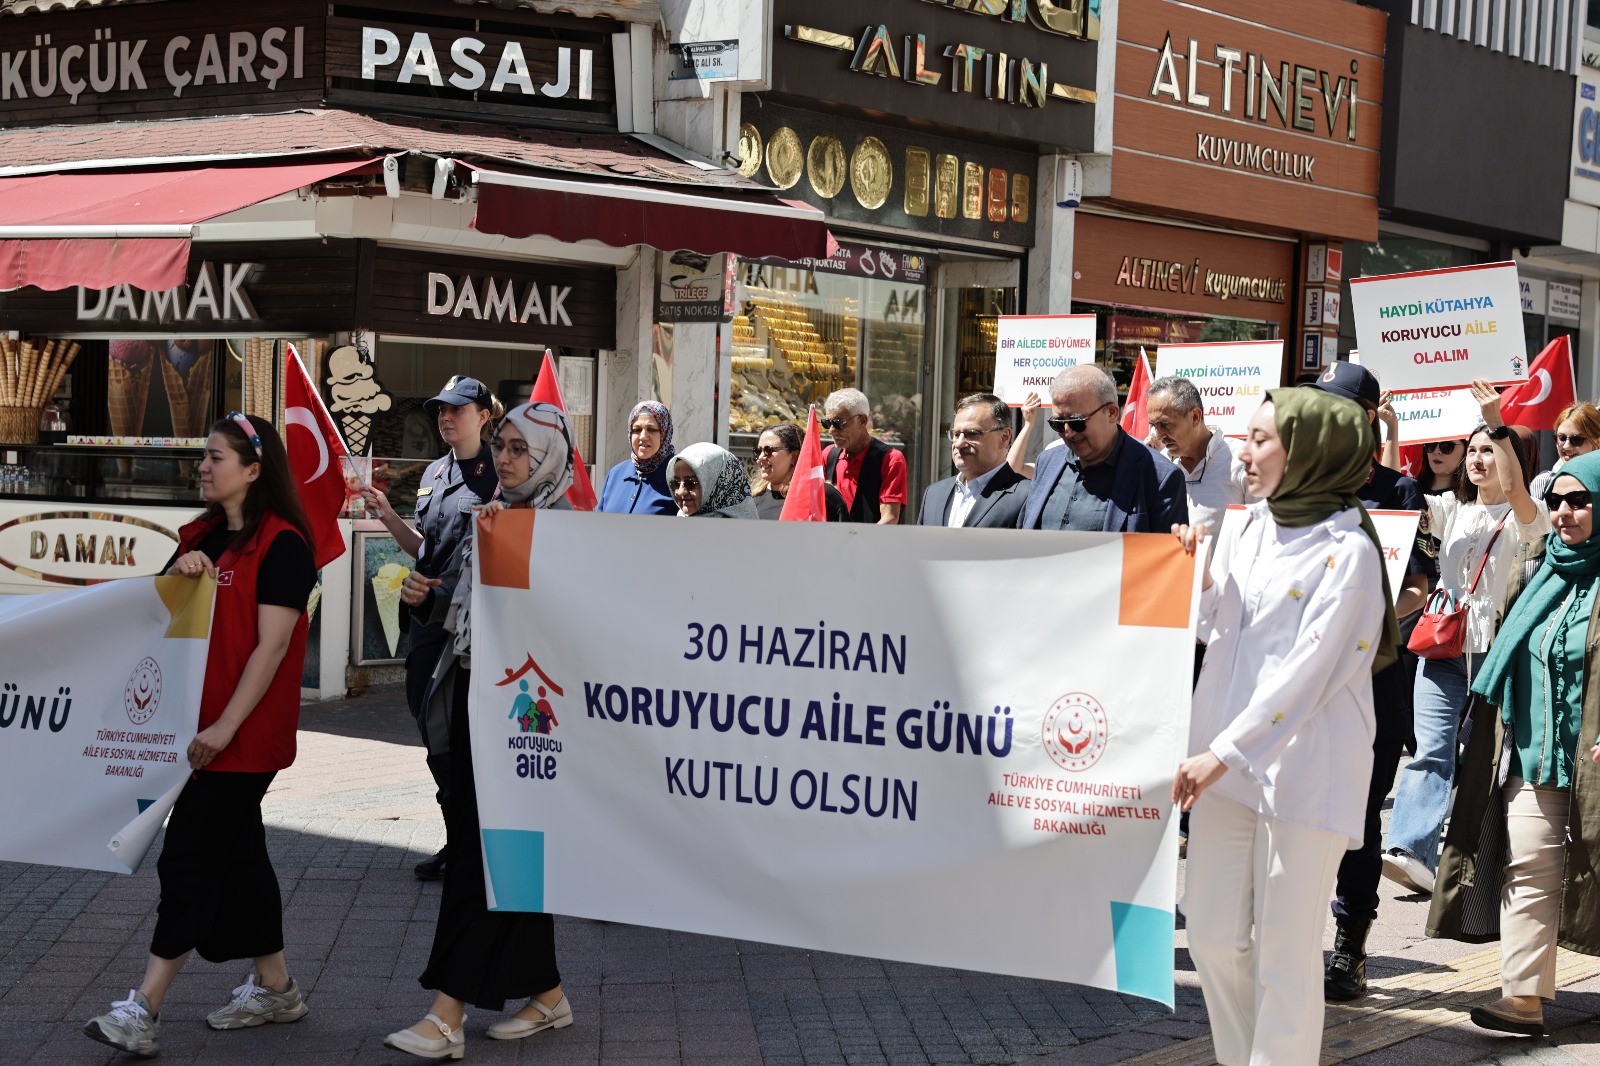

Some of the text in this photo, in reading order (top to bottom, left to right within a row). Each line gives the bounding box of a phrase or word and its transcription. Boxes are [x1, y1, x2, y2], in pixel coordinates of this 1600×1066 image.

[2, 26, 304, 105] KÜÇÜK ÇARŞI
[361, 26, 592, 101] PASAJI
[850, 24, 1048, 108] ALTIN
[1149, 30, 1358, 141] ALTINEVİ
[1196, 133, 1315, 181] KUYUMCULUK
[1115, 256, 1287, 299] ALTINEVİ kuyumculuk
[76, 261, 252, 325] DAMAK
[427, 271, 573, 327] DAMAK
[660, 305, 720, 317] SATIŞ NOKTASI
[1380, 296, 1494, 319] HAYDİ KÜTAHYA
[1001, 337, 1091, 349] BİR AİLEDE BÜYÜMEK
[1381, 320, 1498, 343] KORUYUCU AİLE
[1014, 356, 1076, 369] HER ÇOCUĞUN
[1413, 348, 1469, 365] OLALIM
[1175, 365, 1261, 378] HAYDİ KÜTAHYA
[1235, 384, 1261, 396] AİLE
[30, 530, 136, 567] DAMAK
[684, 621, 907, 675] 30 HAZİRAN
[584, 682, 1013, 758] KORUYUCU AİLE GÜNÜ
[96, 729, 176, 746] TÜRKİYE CUMHURİYETİ
[83, 744, 178, 763] AİLE VE SOSYAL HİZMETLER
[516, 753, 557, 780] aile
[105, 765, 144, 778] BAKANLIĞI
[666, 757, 918, 821] KUTLU OLSUN
[1003, 772, 1142, 800] TÜRKİYE CUMHURİYETİ
[987, 790, 1161, 820] AİLE VE SOSYAL HİZMETLER
[1033, 818, 1107, 836] BAKANLIĞI
